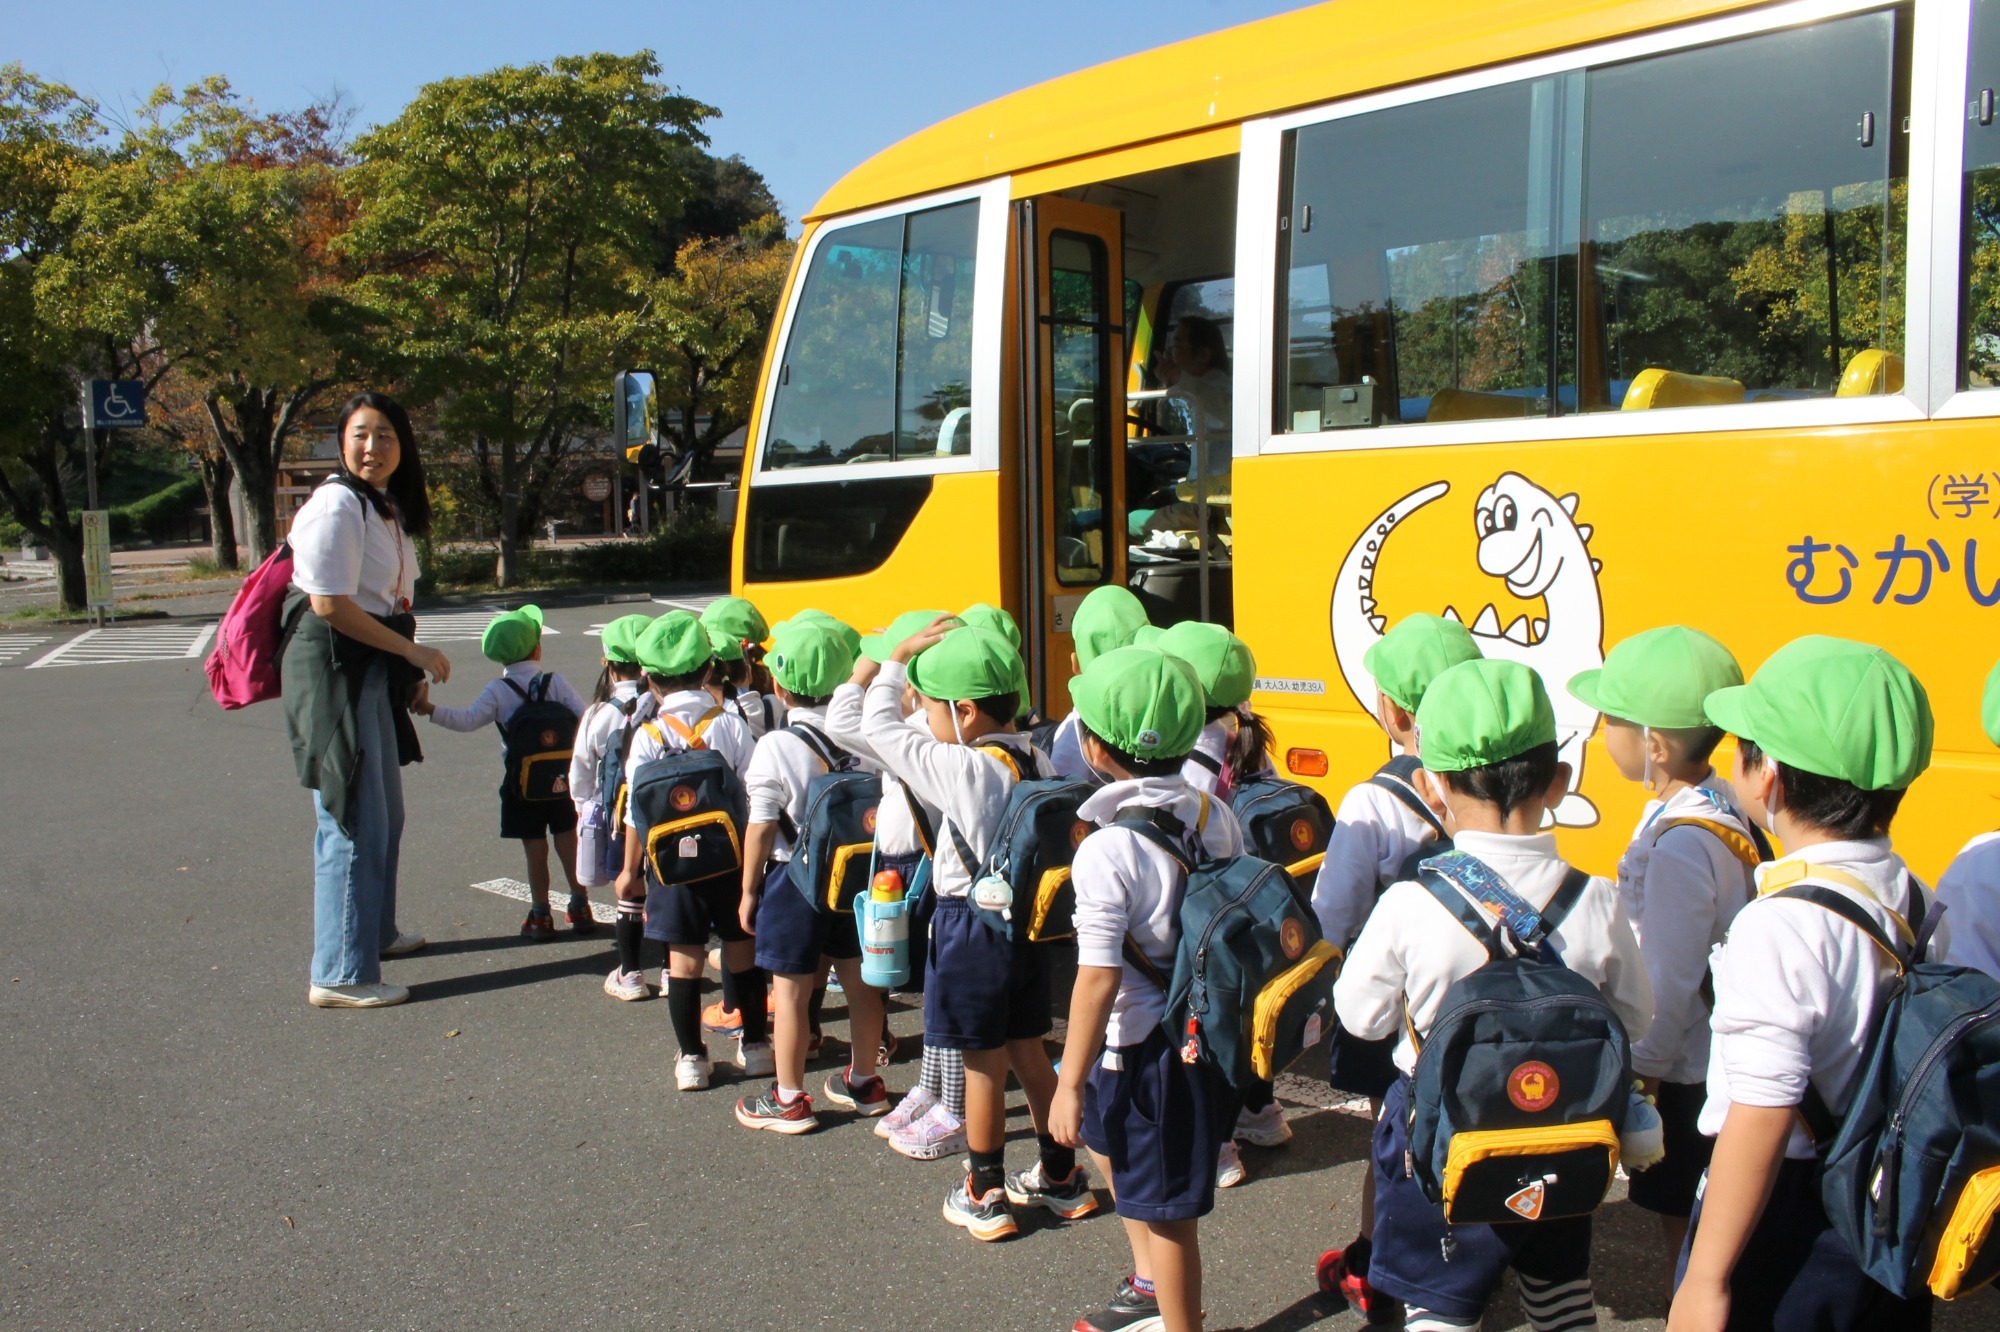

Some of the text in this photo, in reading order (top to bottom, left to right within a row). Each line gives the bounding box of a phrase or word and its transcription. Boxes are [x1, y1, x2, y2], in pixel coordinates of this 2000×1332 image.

[1264, 680, 1290, 691] 大人3人
[1292, 681, 1324, 692] 幼児39人
